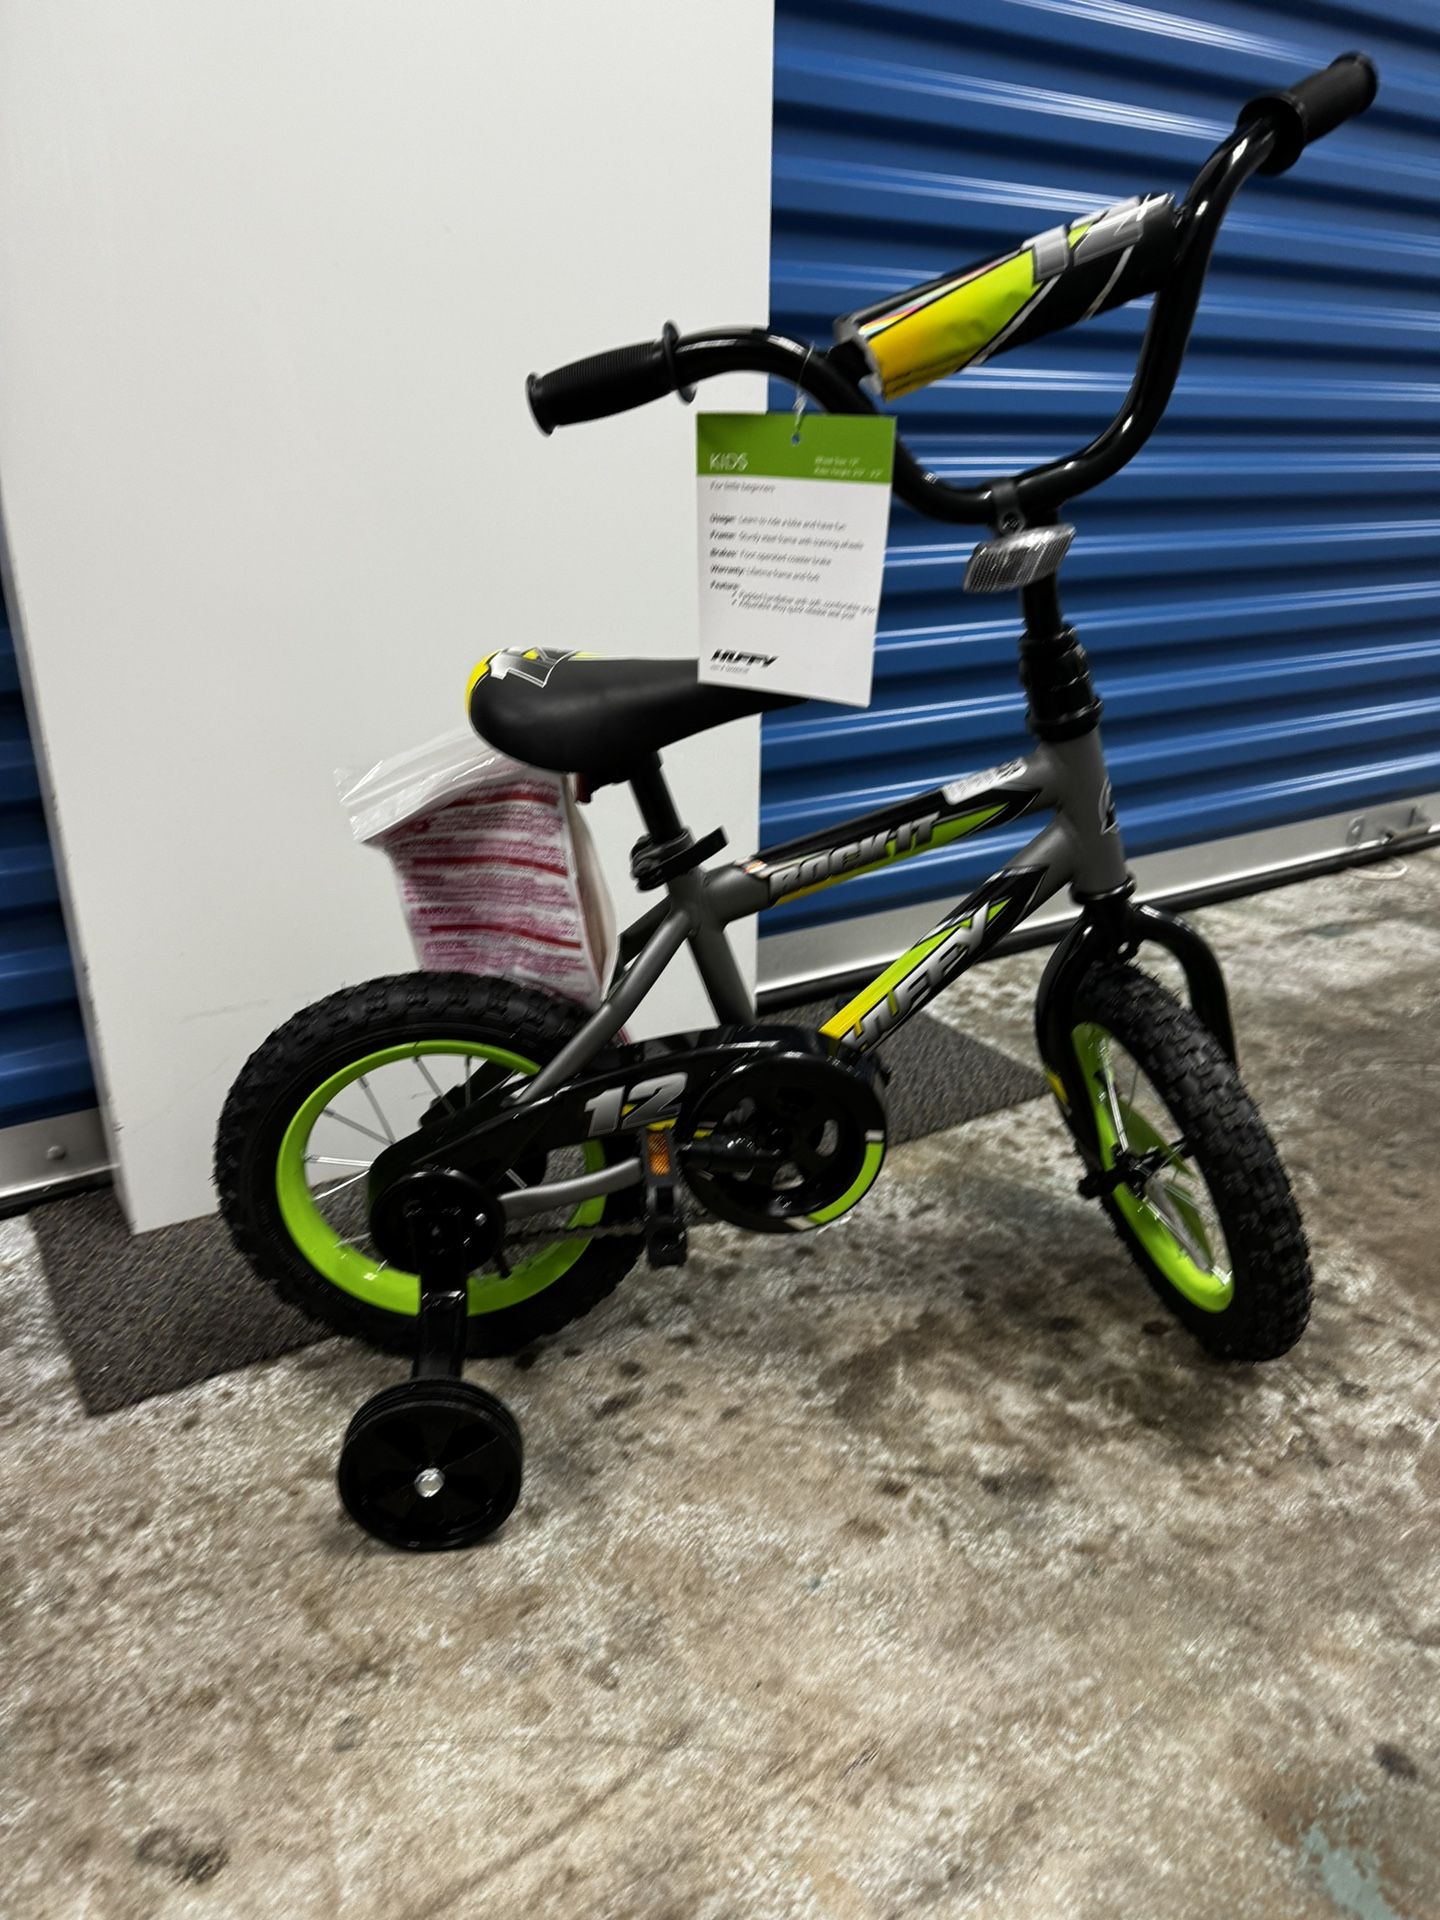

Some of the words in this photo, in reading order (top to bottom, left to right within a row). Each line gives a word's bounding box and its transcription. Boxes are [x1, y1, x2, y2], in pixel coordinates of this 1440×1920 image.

[709, 452, 750, 471] KIDS
[710, 480, 723, 490] For
[711, 563, 744, 578] Warranty:
[711, 648, 779, 668] HUFFY
[841, 902, 990, 1051] HUFFY
[584, 1071, 689, 1137] 12
